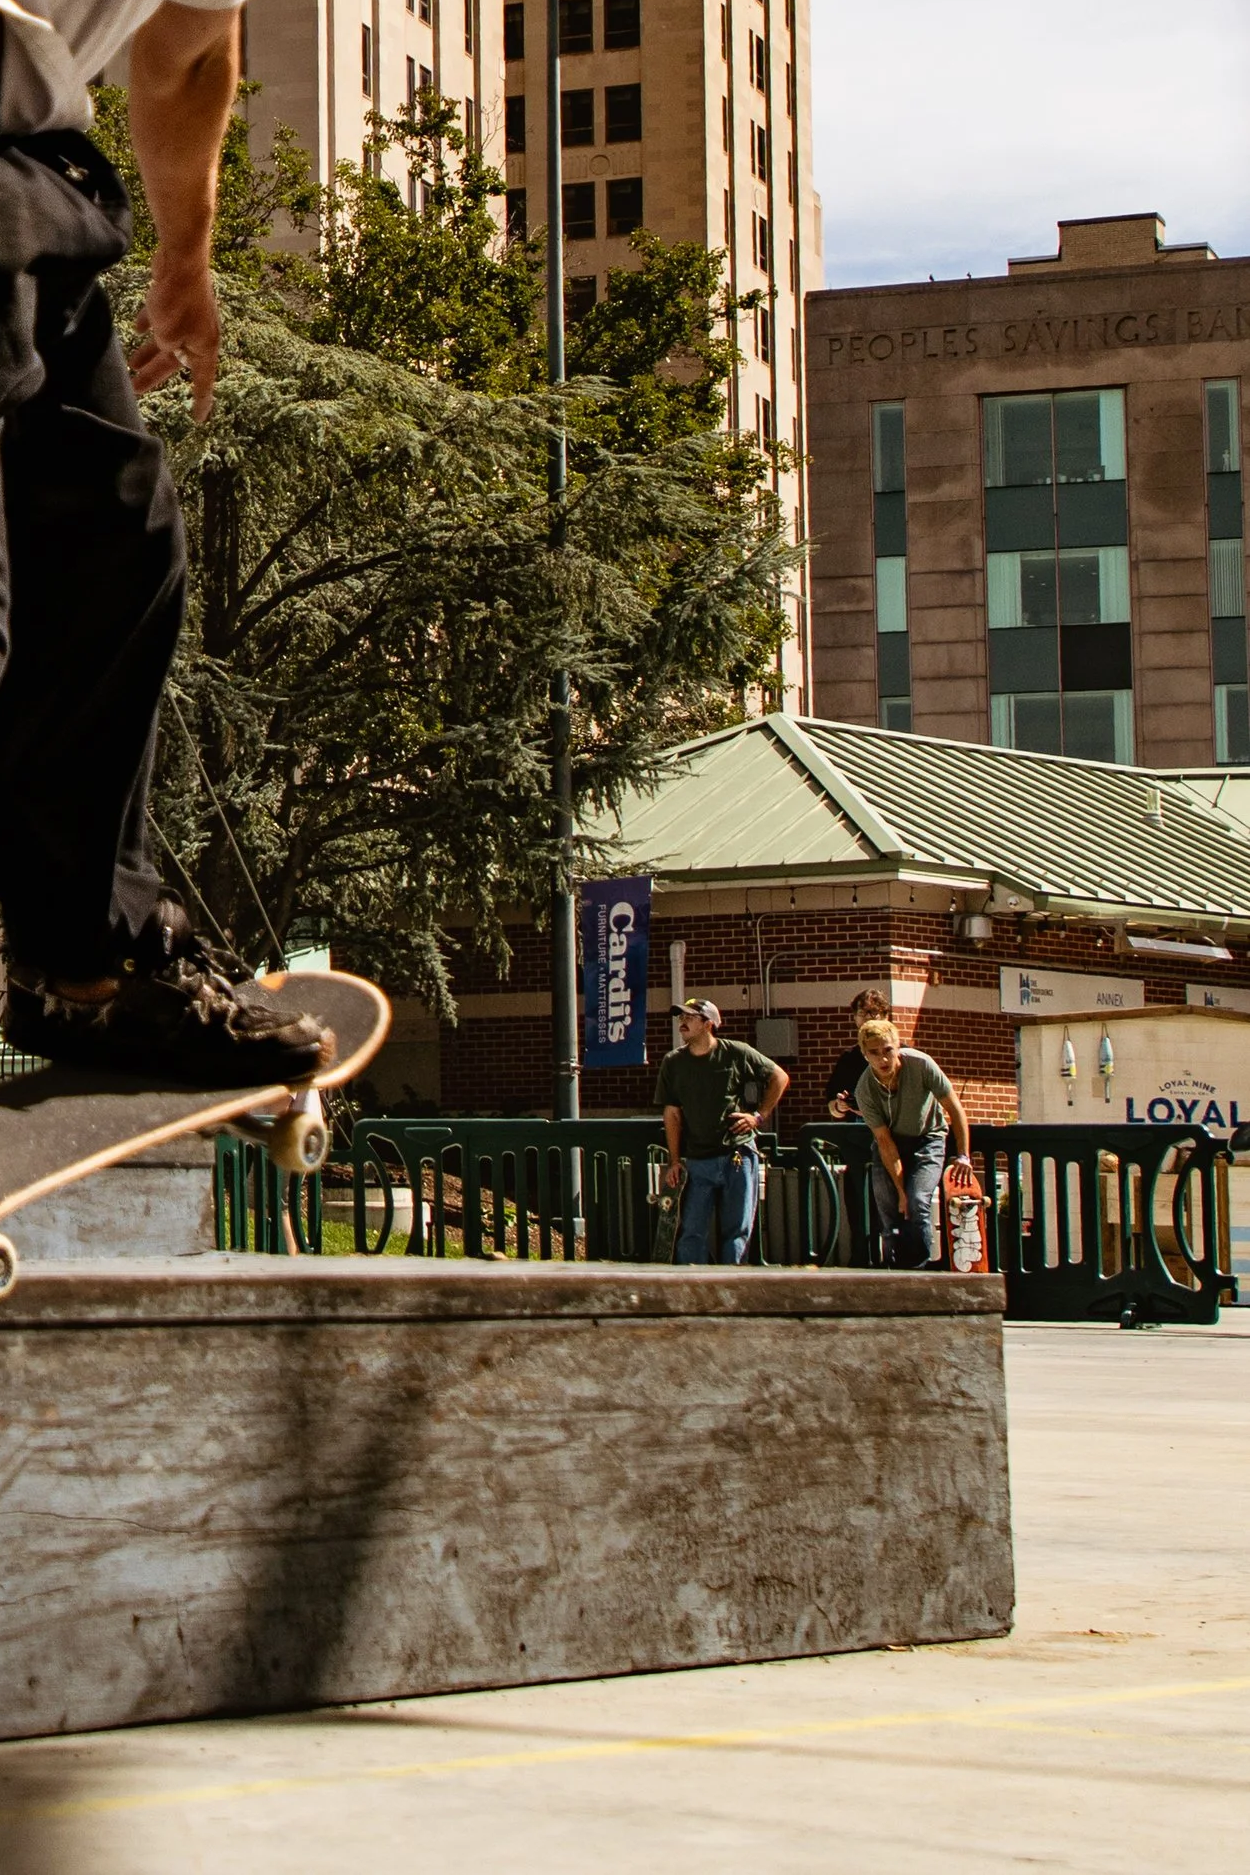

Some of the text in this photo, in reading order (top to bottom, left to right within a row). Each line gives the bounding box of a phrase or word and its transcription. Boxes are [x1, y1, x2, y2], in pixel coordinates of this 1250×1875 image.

[828, 327, 979, 366] PEOPLES
[1004, 313, 1159, 353] SAVINGS
[597, 903, 607, 1044] FURNITURE MATTRESSES
[608, 901, 635, 1043] Cardi's
[1096, 992, 1125, 1007] ANNEX
[1158, 1079, 1190, 1092] LOYAL
[1191, 1080, 1217, 1095] NINE
[1125, 1096, 1240, 1129] LOYAL
